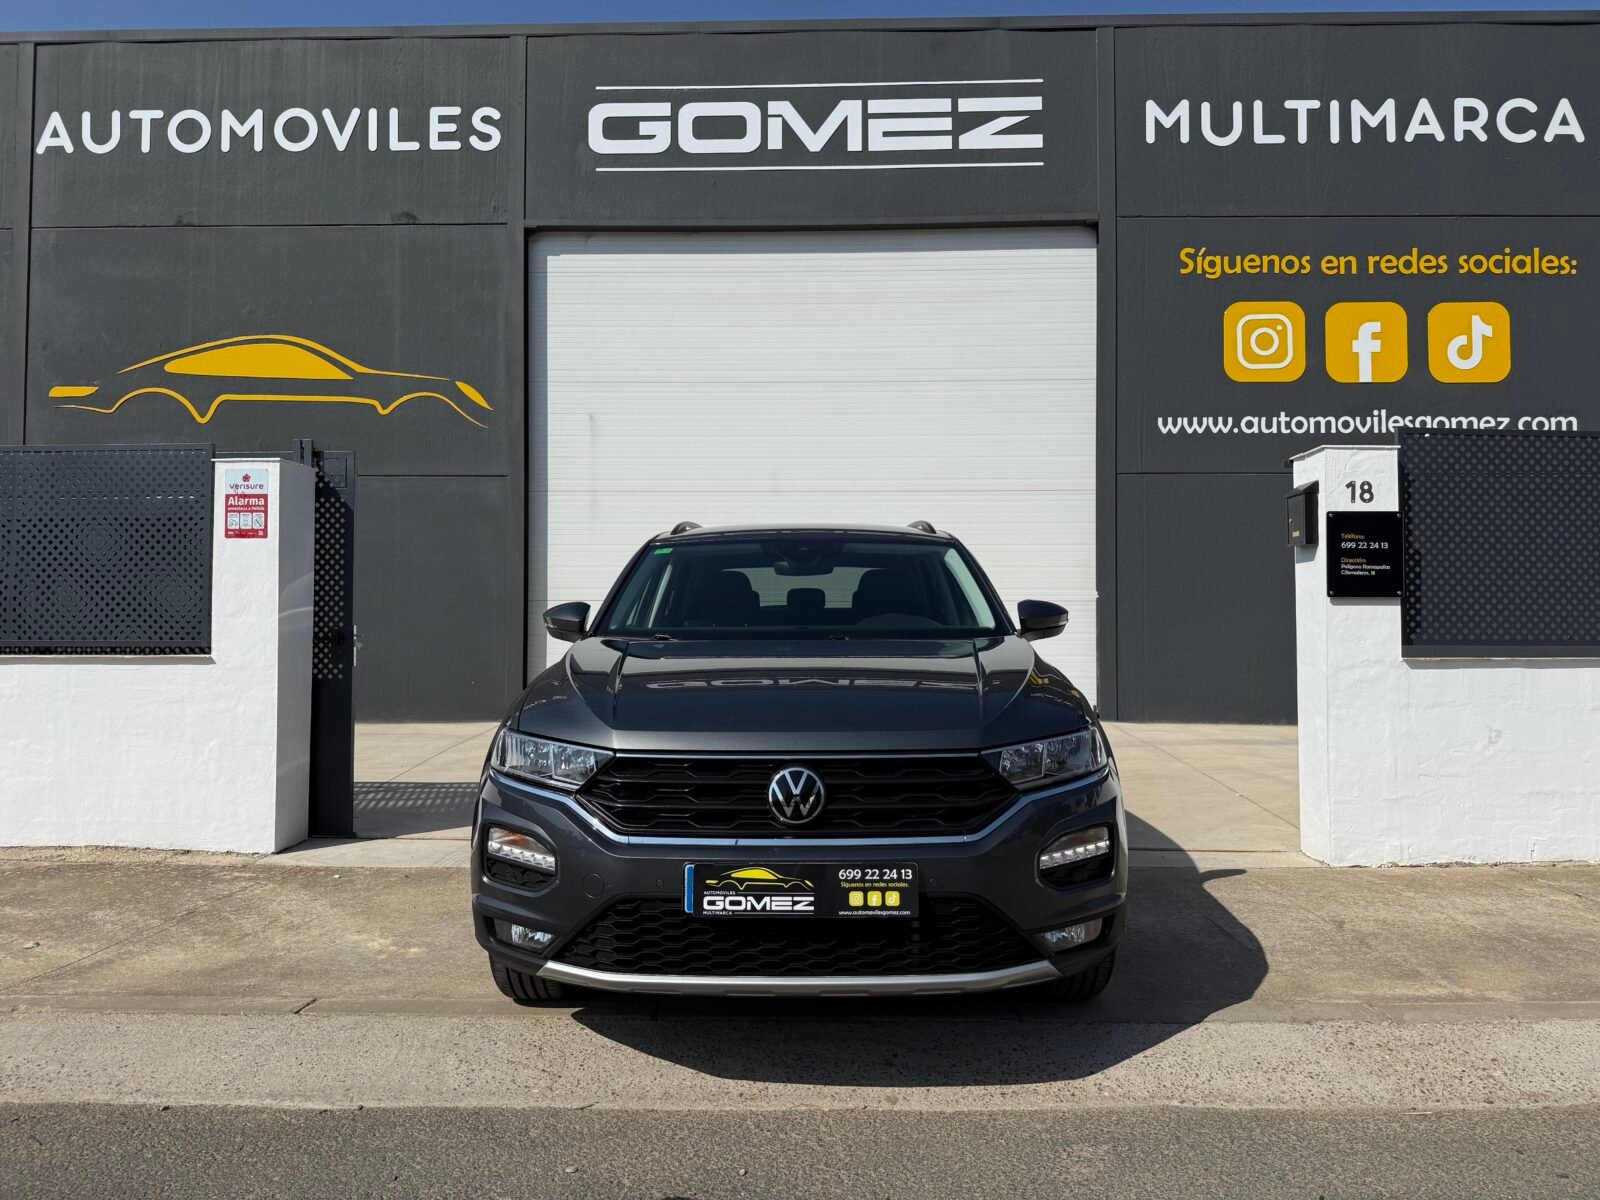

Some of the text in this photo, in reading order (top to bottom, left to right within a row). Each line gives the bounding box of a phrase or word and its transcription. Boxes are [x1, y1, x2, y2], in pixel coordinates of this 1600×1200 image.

[36, 106, 502, 155] AUTOMOVILES
[588, 95, 1044, 155] GOMEZ
[1145, 97, 1586, 147] MULTIMARCA
[1179, 246, 1578, 280] Síguenos en redes sociales:
[1157, 408, 1578, 434] www.automovilesgomezcom
[229, 482, 264, 490] verisure
[1345, 480, 1375, 504] 18
[228, 496, 265, 506] Alarma
[1341, 541, 1389, 549] 699 22 24 13
[838, 868, 913, 880] 699 22 24 13
[703, 896, 815, 911] GOMEZ
